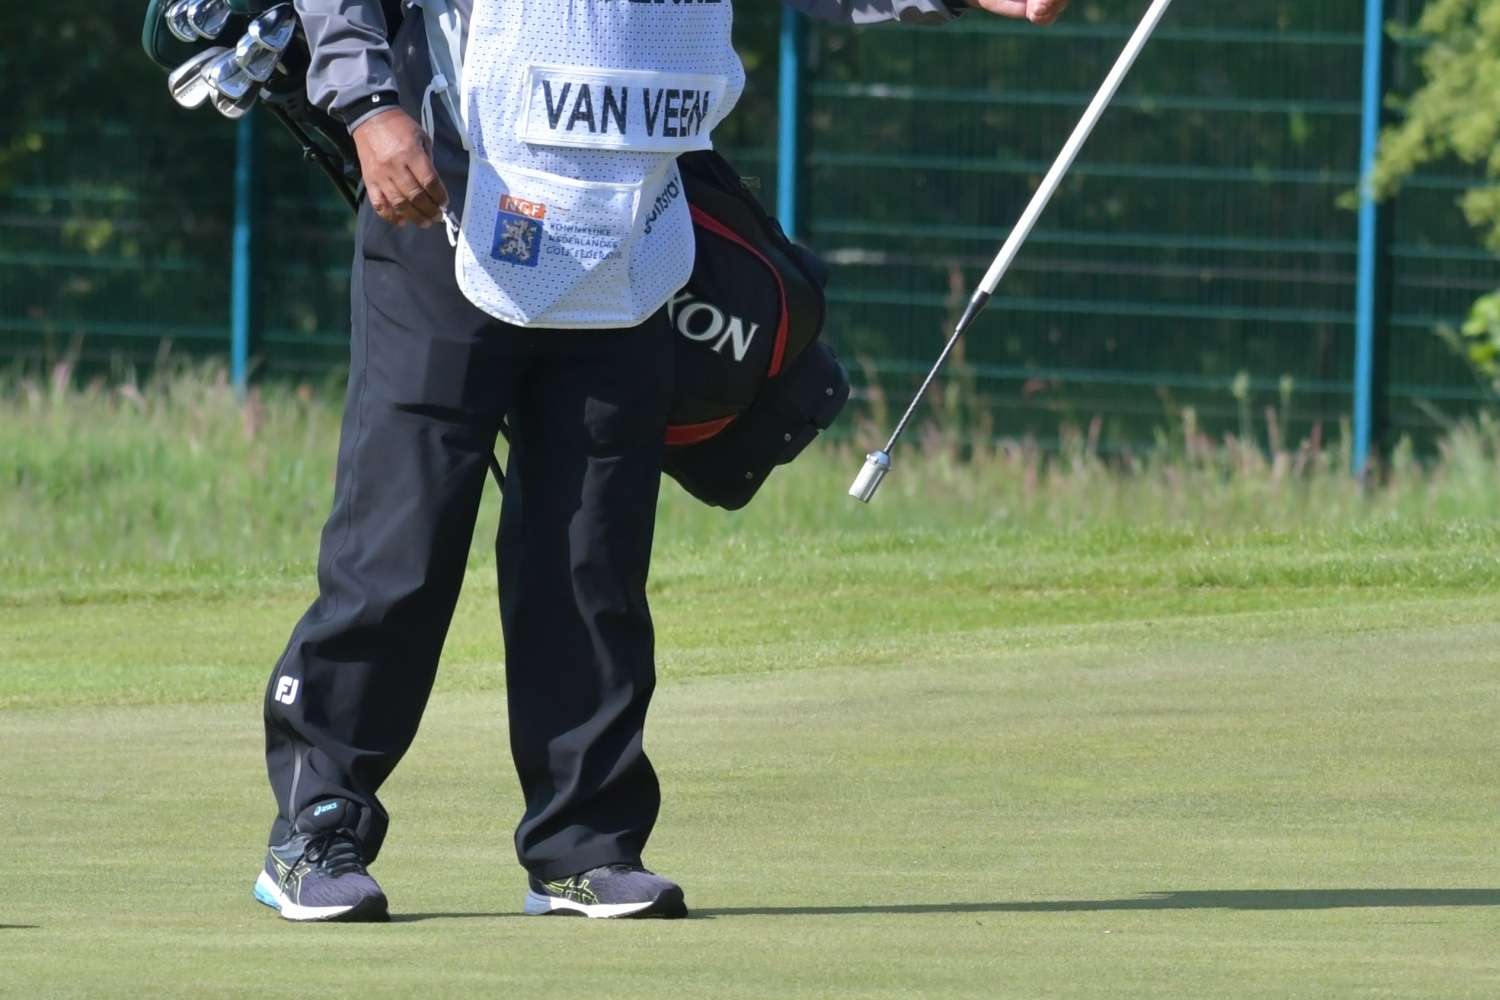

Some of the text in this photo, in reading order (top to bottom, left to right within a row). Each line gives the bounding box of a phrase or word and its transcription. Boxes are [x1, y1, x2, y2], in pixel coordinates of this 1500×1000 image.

[542, 80, 711, 138] VAN VEEN
[505, 197, 540, 216] NGF
[275, 675, 299, 705] FJ
